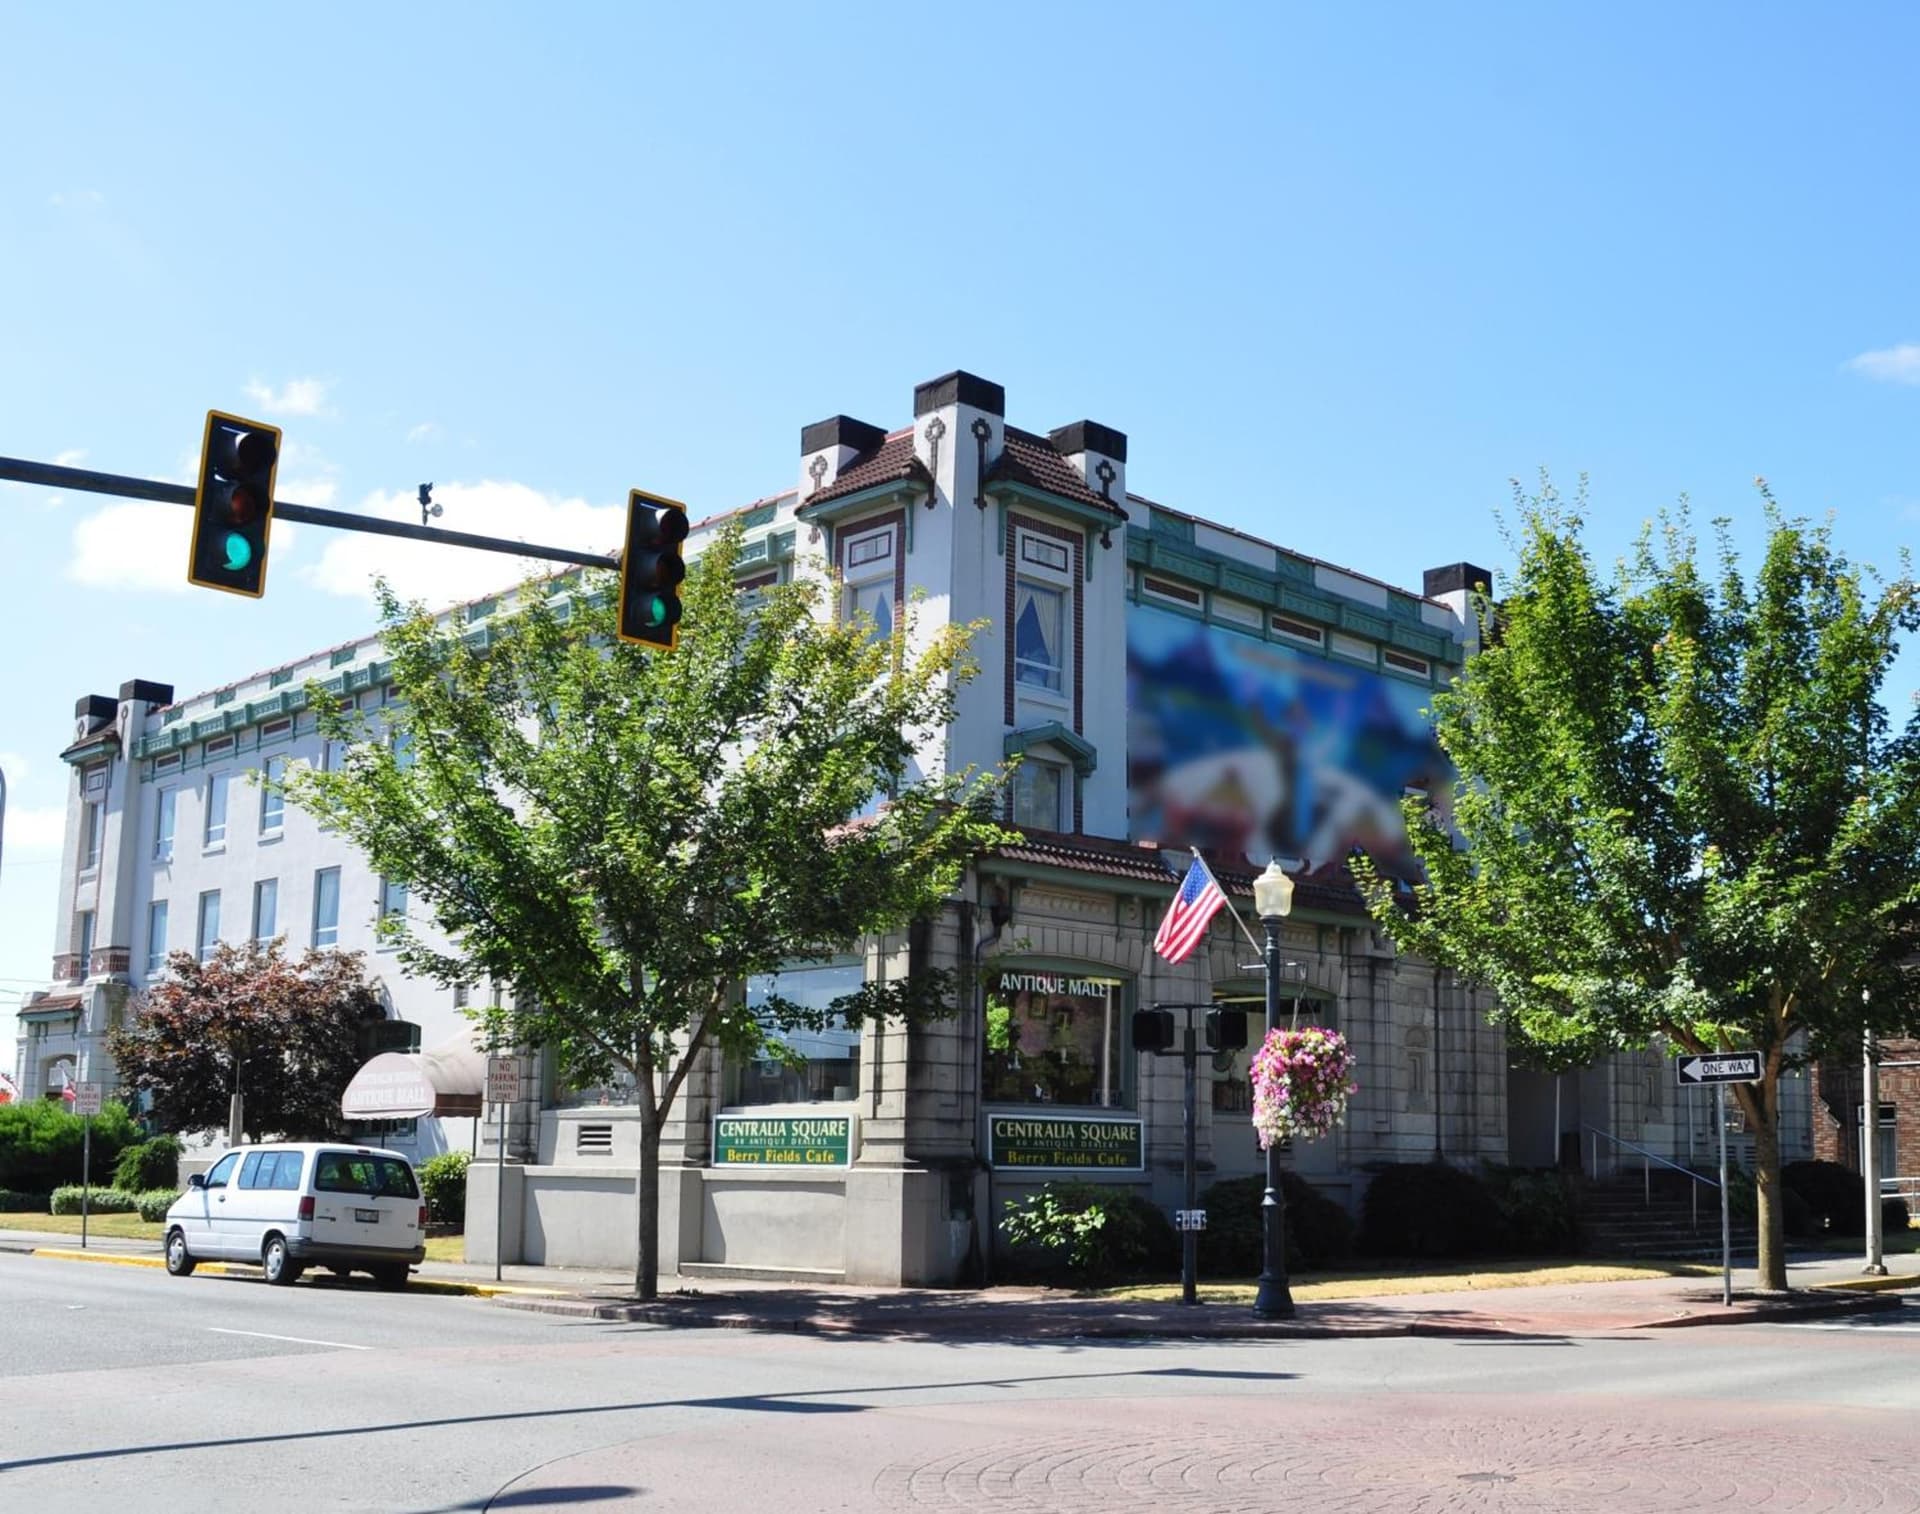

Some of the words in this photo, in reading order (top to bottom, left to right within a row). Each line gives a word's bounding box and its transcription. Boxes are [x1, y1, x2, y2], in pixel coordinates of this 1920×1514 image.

[1000, 973, 1065, 994] ANTIQUE
[1068, 979, 1106, 997] MALL
[499, 1062, 511, 1072] NO
[1702, 1063, 1725, 1074] ONE
[1728, 1061, 1751, 1073] WAY
[491, 1072, 518, 1082] PARKING
[719, 1120, 787, 1137] CENTRALIA
[791, 1120, 847, 1139] SQUARE
[995, 1121, 1075, 1139] CENTRALIA
[1080, 1123, 1137, 1142] SQUARE
[749, 1137, 785, 1146] ANTIQUE
[791, 1137, 828, 1146] DEALERS
[1033, 1140, 1074, 1149] ANTIQUE
[1081, 1141, 1120, 1149] DEALERS
[727, 1149, 760, 1163] Berry
[766, 1149, 801, 1162] Fields
[806, 1149, 835, 1163] Cafe
[1007, 1150, 1047, 1165] Berry
[1053, 1151, 1092, 1165] Fields
[1097, 1152, 1128, 1166] Cafe
